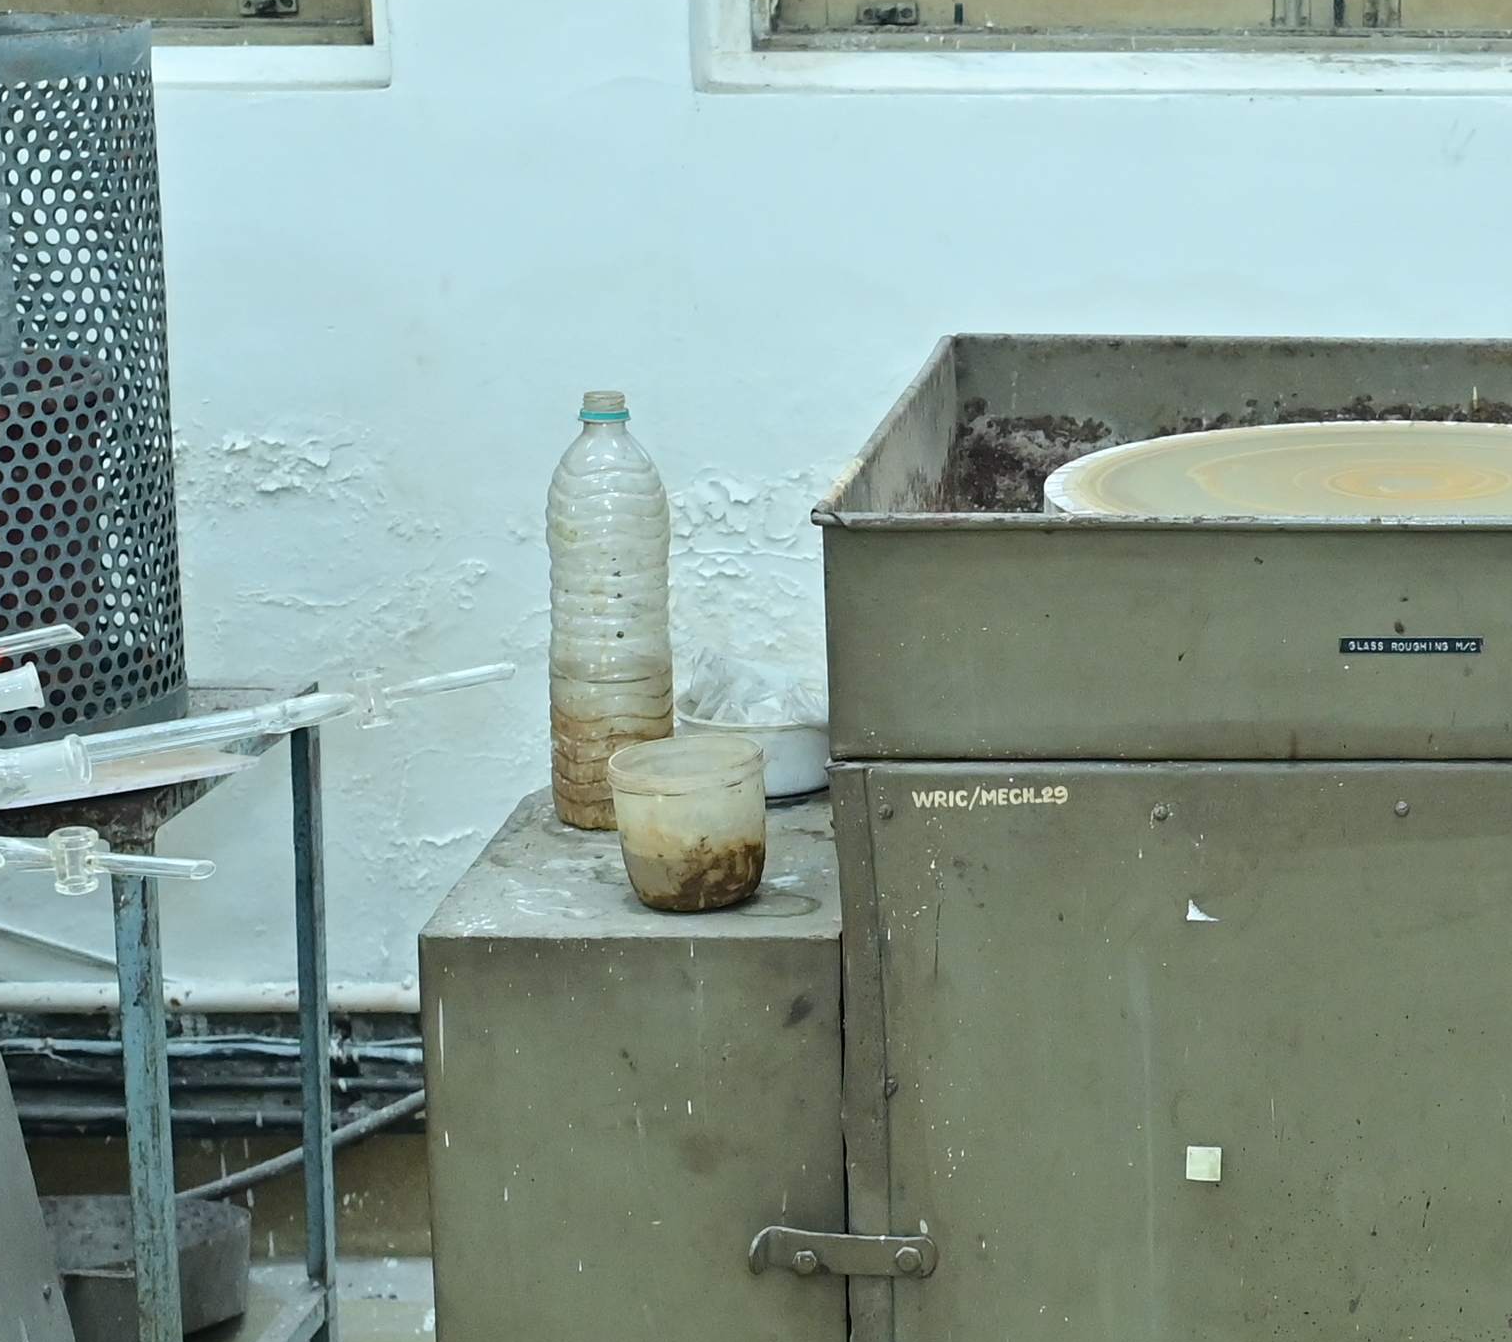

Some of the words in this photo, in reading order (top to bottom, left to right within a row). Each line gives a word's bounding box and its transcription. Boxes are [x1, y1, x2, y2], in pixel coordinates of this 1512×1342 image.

[1348, 640, 1384, 652] GLASS
[1391, 641, 1449, 652] ROUGHING
[1455, 641, 1477, 652] M/C
